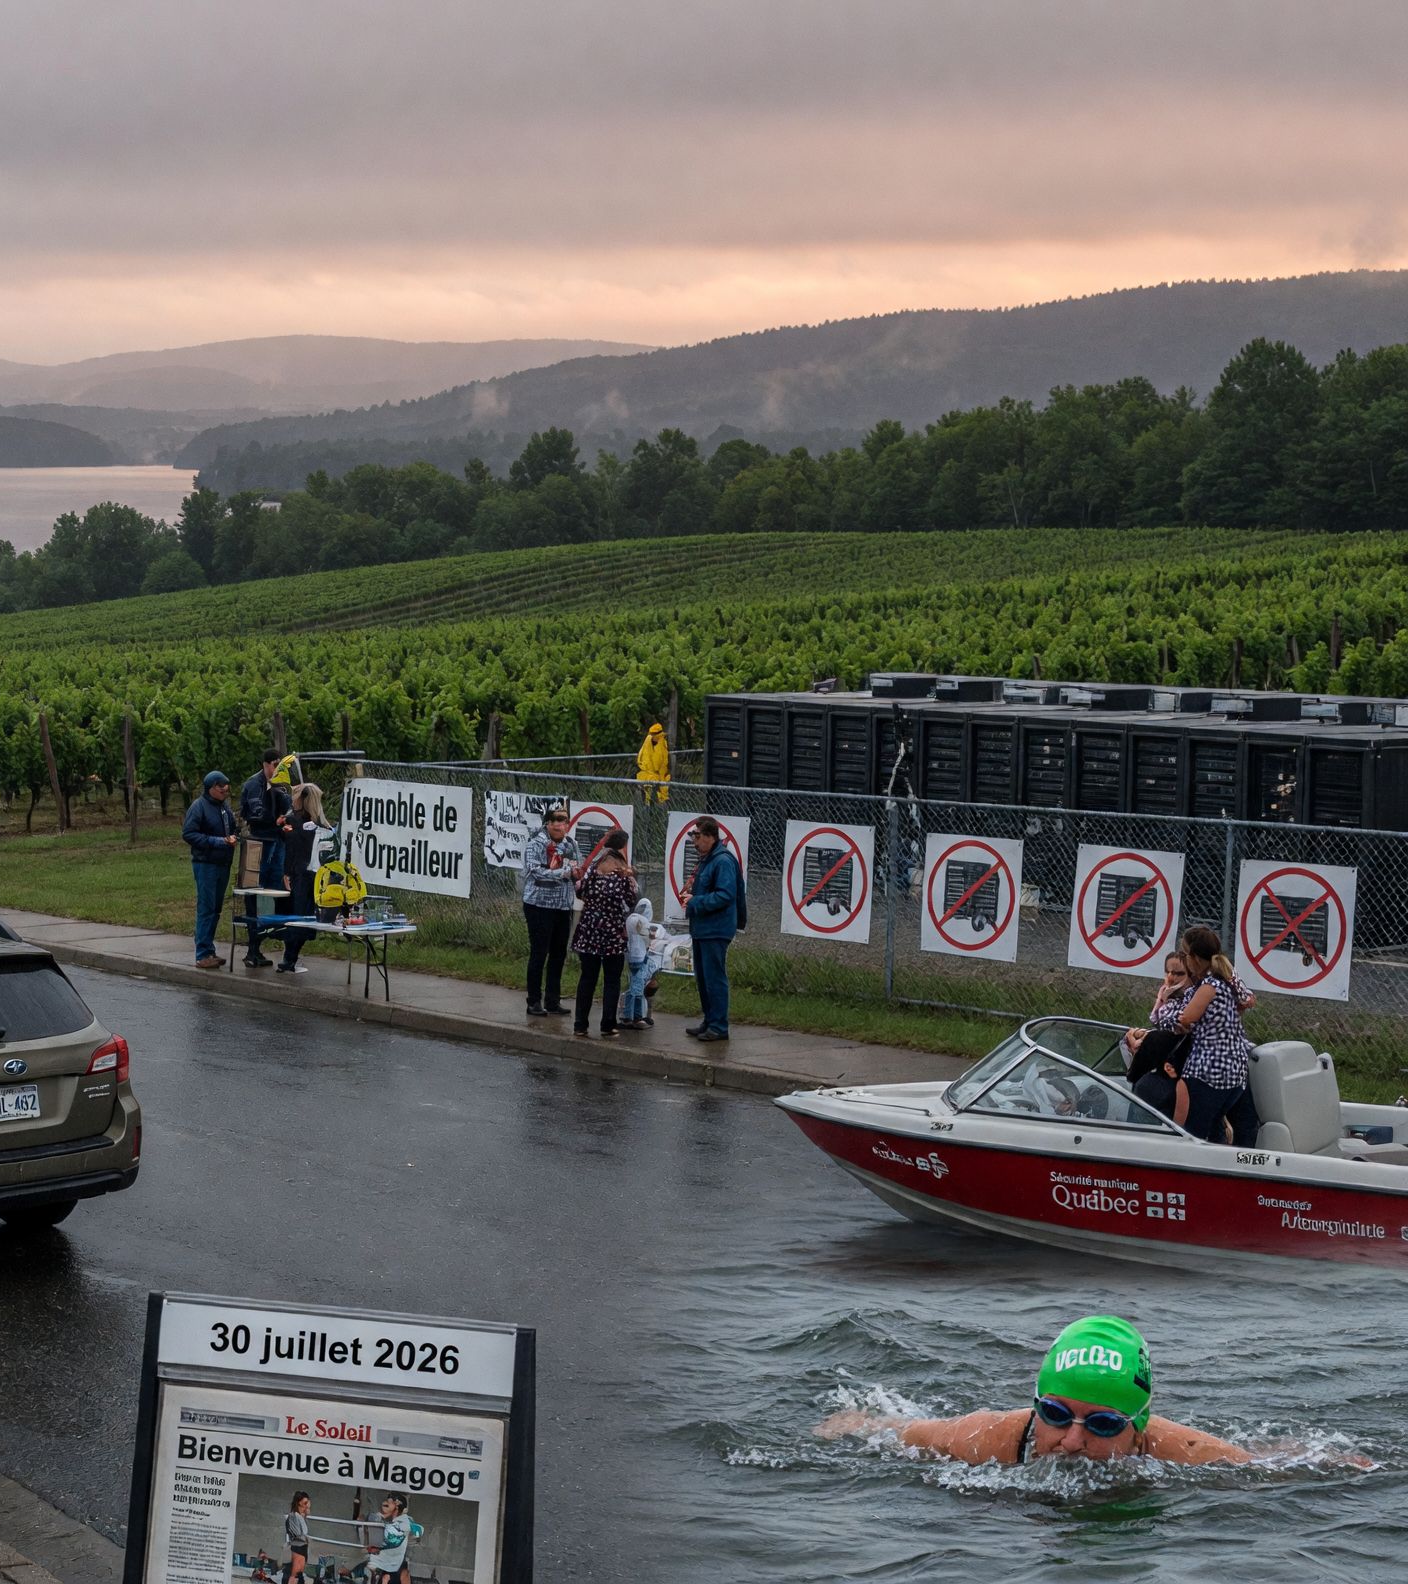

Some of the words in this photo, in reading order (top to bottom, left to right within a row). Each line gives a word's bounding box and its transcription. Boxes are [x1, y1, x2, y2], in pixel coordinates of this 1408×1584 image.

[346, 787, 426, 831] Vignoble
[433, 796, 457, 833] de
[209, 1322, 251, 1355] 30
[259, 1327, 363, 1366] juillet
[373, 1338, 460, 1375] 2026
[286, 1415, 309, 1436] Le
[314, 1418, 372, 1443] Soleil
[177, 1434, 330, 1475] Bienvenue
[337, 1452, 355, 1478] à
[364, 1455, 465, 1497] Magog
